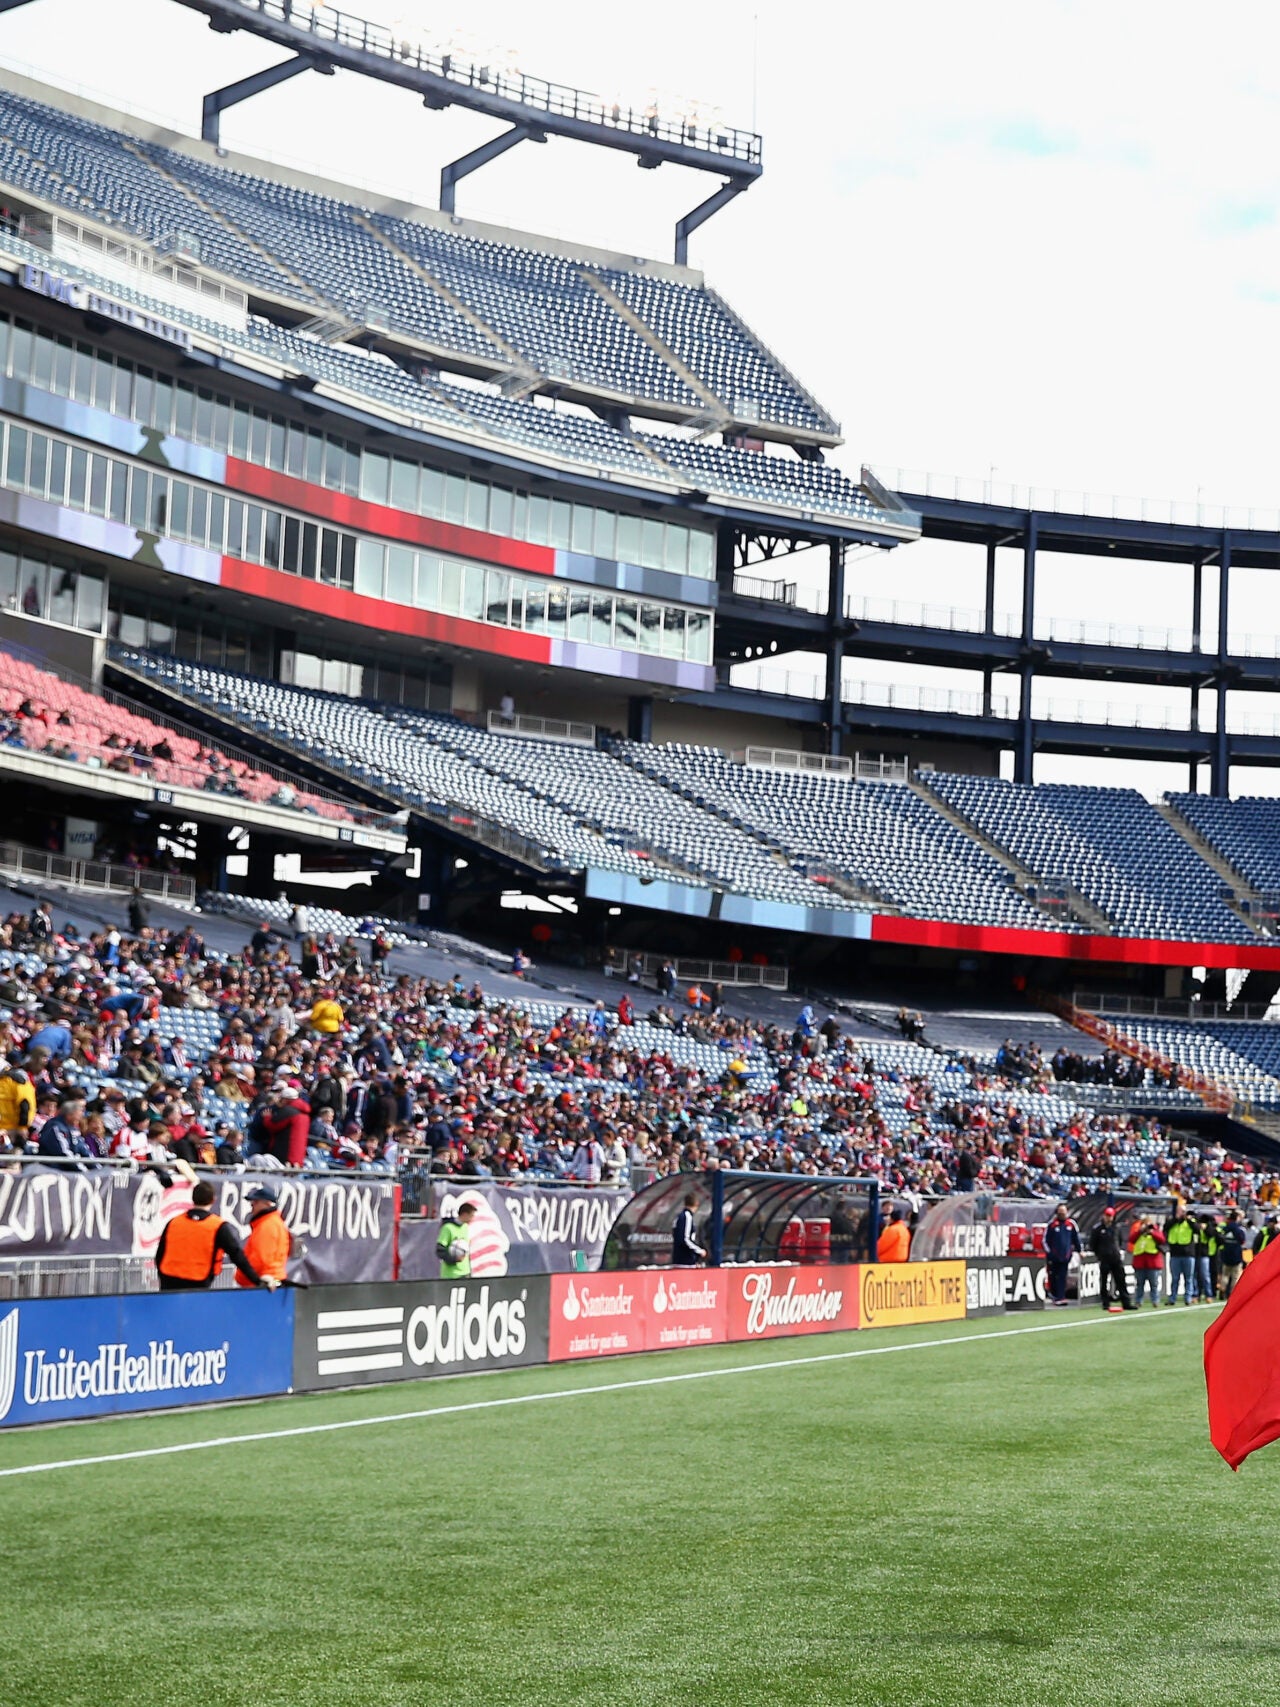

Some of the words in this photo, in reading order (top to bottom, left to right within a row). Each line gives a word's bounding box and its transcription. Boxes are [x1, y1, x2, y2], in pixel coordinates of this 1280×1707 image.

[581, 1284, 634, 1318] Santander
[668, 1280, 718, 1311] Santander
[742, 1273, 843, 1334] Budweiser
[863, 1270, 927, 1322] Continental
[940, 1277, 961, 1304] TIRE
[407, 1286, 527, 1366] adidas
[24, 1339, 226, 1405] UnitedHealthcare
